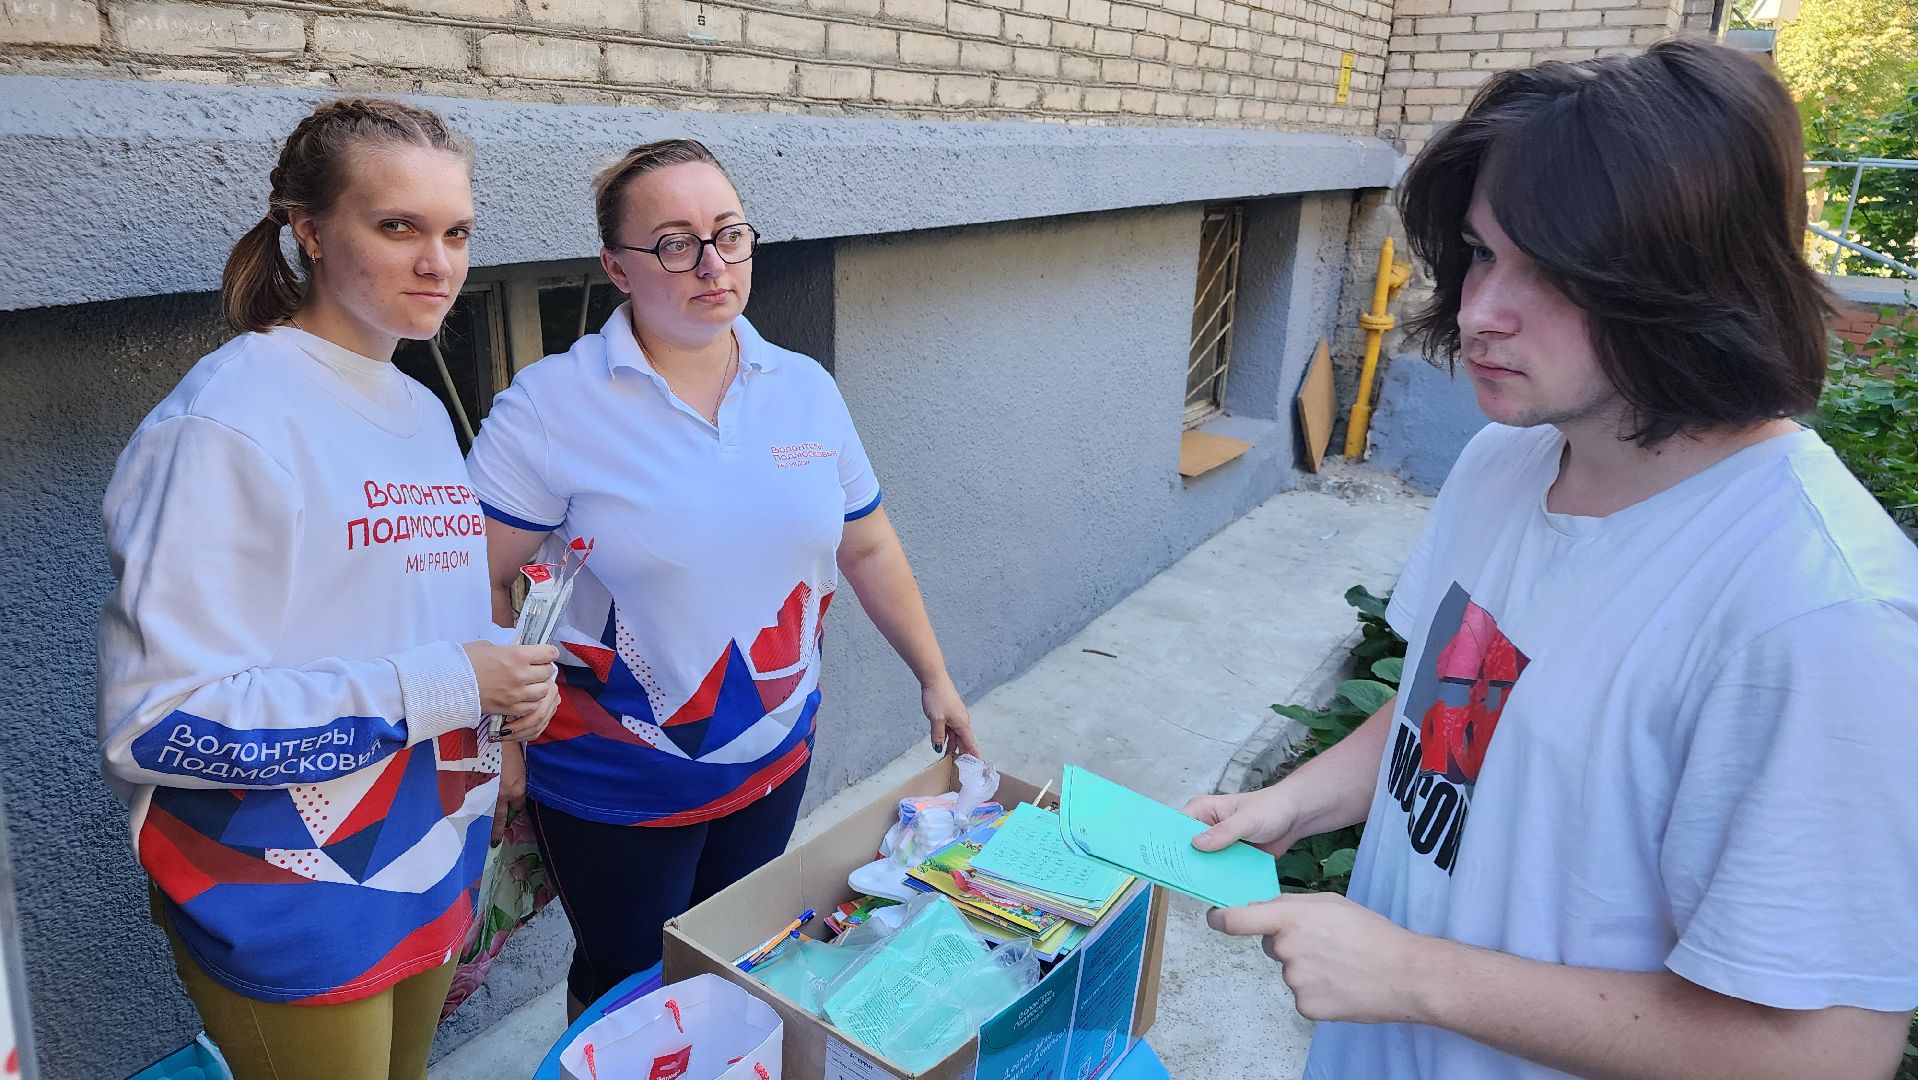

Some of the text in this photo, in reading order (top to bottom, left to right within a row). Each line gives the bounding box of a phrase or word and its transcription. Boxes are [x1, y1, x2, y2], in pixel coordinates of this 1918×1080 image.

[347, 513, 487, 550] ПОДМОСКОВ
[405, 551, 469, 573] МЫ РЯДОМ
[158, 738, 382, 779] ПОДМОСКОВЬЯ
[168, 724, 355, 762] ВОЛОНТЕРЫ
